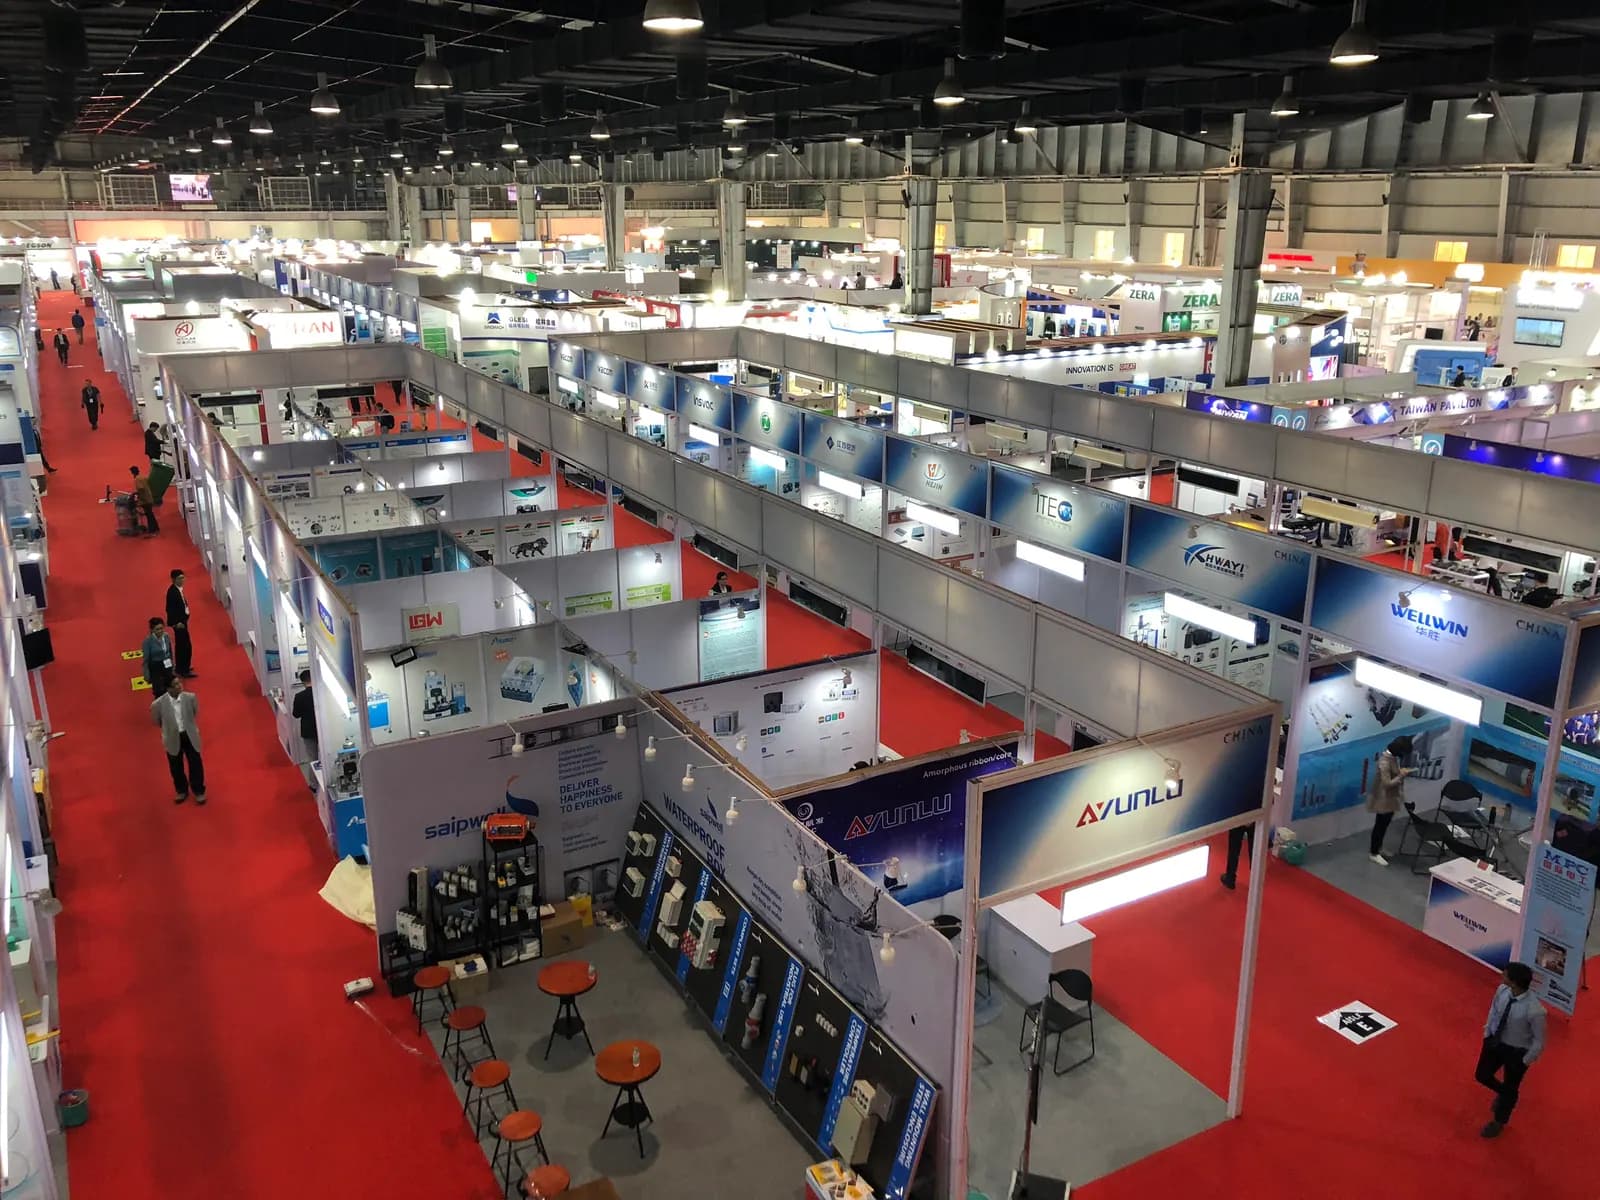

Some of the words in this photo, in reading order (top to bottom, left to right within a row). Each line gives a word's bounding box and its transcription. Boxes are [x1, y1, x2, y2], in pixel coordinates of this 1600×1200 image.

[1129, 289, 1155, 301] ZERA
[1183, 293, 1219, 308] ZERA
[1273, 291, 1300, 302] ZERA
[1065, 364, 1106, 375] INNOVATION
[1107, 363, 1114, 372] IS
[1400, 403, 1437, 416] TAIWAN
[1391, 602, 1469, 638] WELLWIN
[1515, 619, 1562, 641] CHINA
[1223, 726, 1264, 744] CHINA
[560, 777, 600, 795] DELIVER
[560, 784, 614, 804] HAPPINESS
[560, 805, 573, 814] TO
[574, 791, 624, 811] EVERYONE
[663, 791, 725, 861] WATERPROOF
[1543, 849, 1589, 876] MPC
[1356, 1020, 1373, 1032] E
[840, 1019, 857, 1075] CONTROLLER
[844, 1023, 862, 1086] TEMPERATURE
[913, 1081, 926, 1110] STEEL
[919, 1088, 932, 1117] WALL
[898, 1110, 918, 1166] ENCLOSURE
[904, 1116, 924, 1169] MOUNTING
